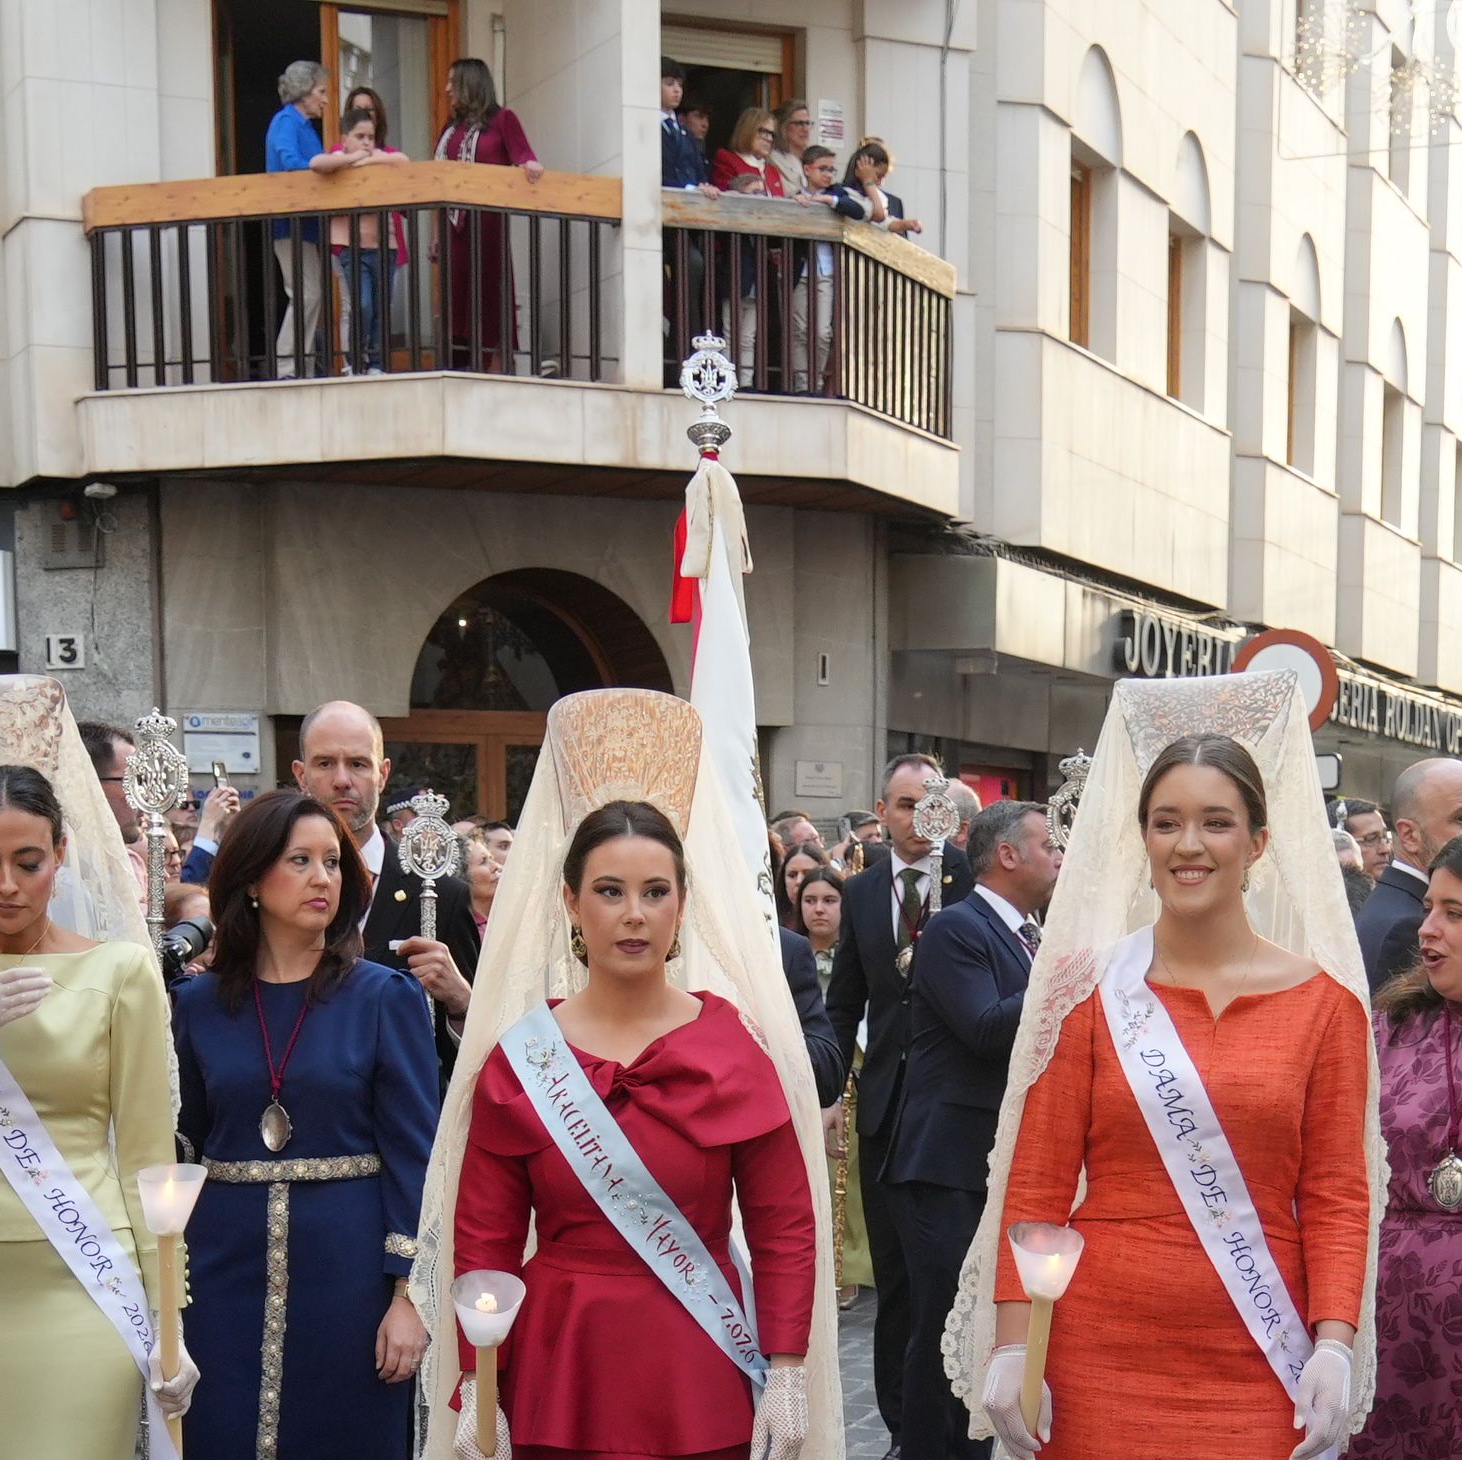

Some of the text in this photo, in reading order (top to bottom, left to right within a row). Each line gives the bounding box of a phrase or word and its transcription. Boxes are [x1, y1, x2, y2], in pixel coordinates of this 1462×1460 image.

[46, 637, 77, 663] 13
[3, 1128, 41, 1172] DE
[44, 1187, 117, 1286] HONOR
[122, 1303, 153, 1354] 2026
[646, 1213, 695, 1282] MAYOR
[1140, 1049, 1282, 1339] DAMA DE HONOR
